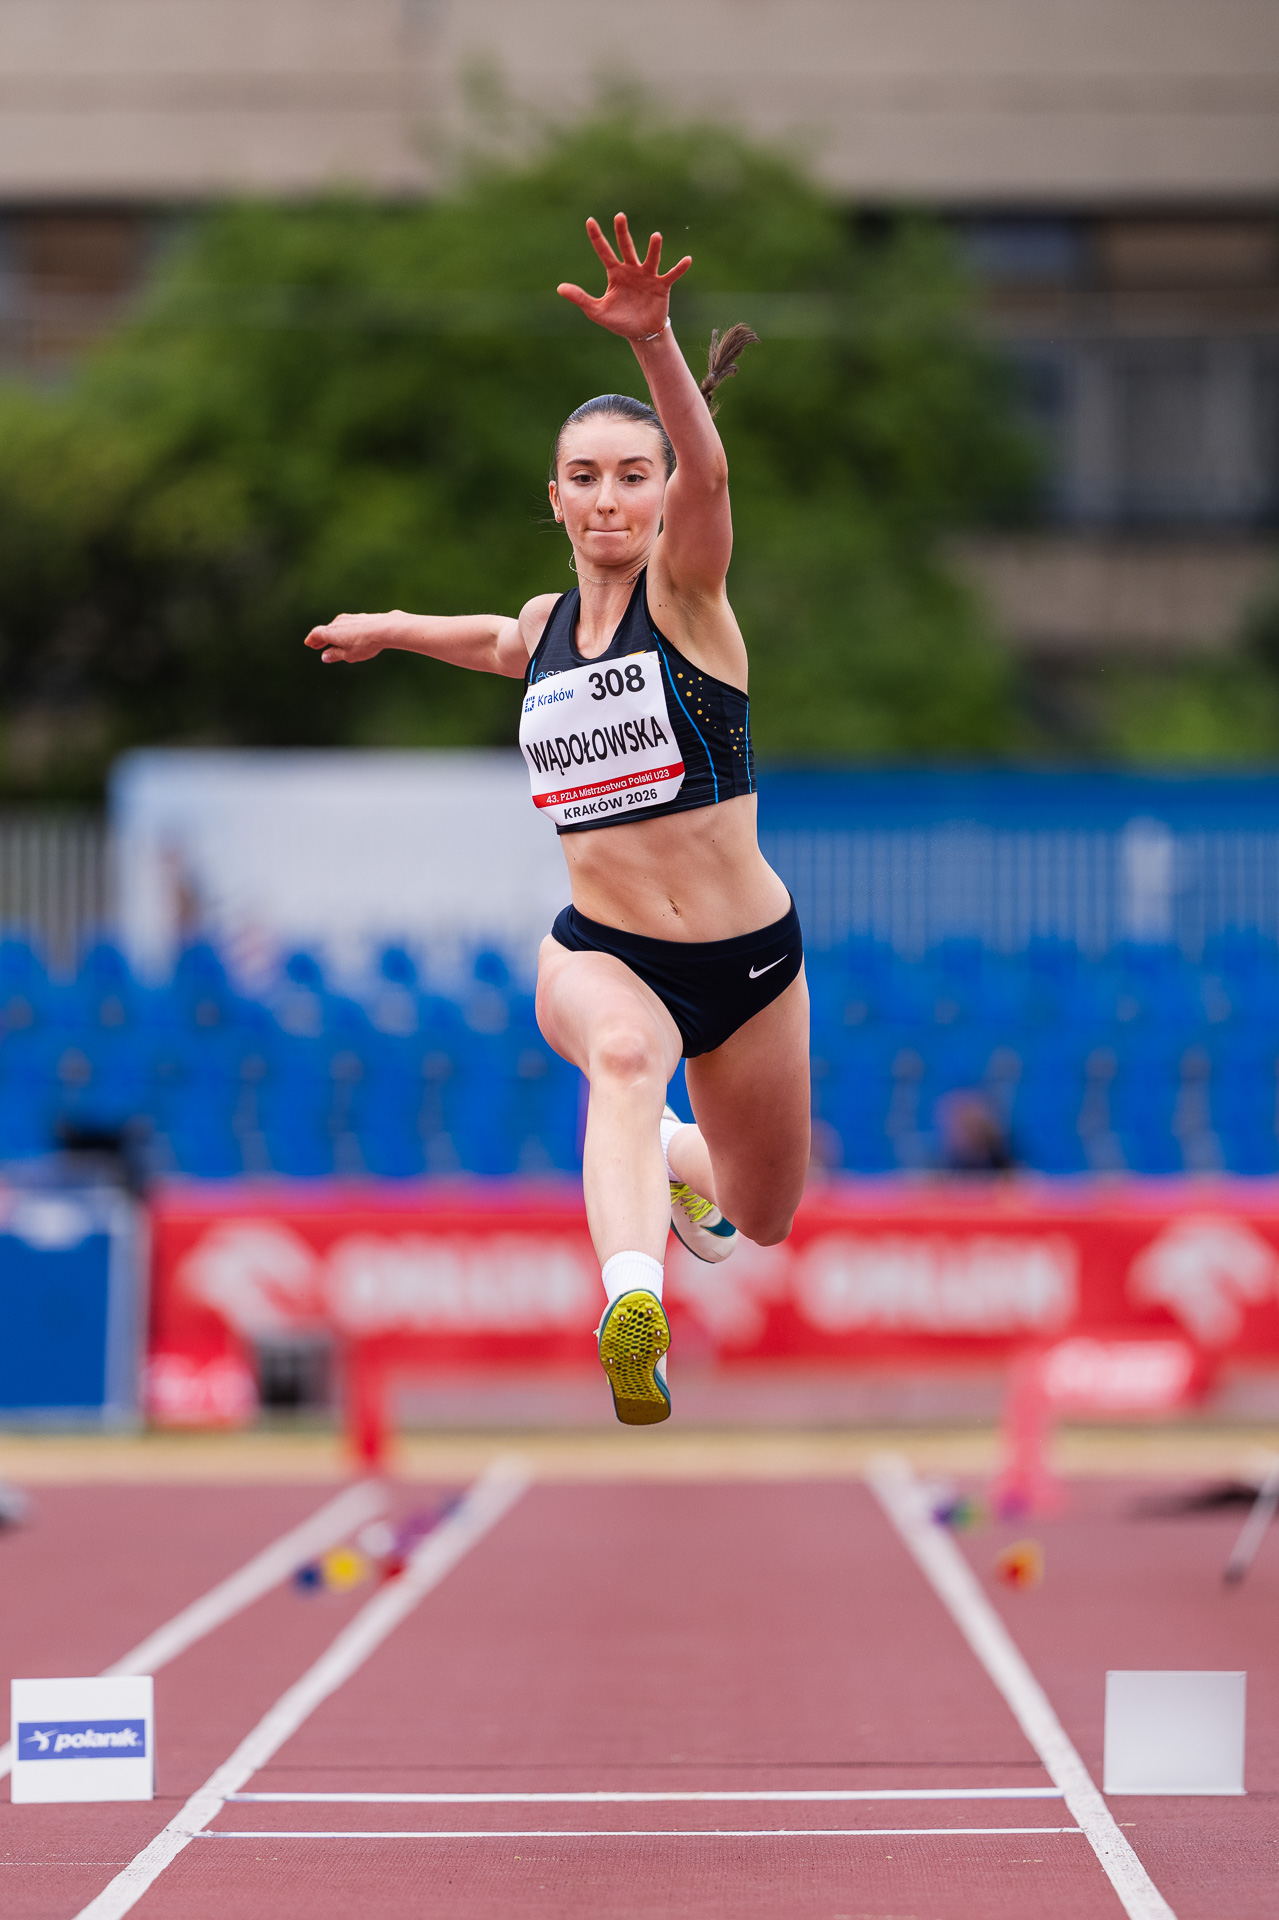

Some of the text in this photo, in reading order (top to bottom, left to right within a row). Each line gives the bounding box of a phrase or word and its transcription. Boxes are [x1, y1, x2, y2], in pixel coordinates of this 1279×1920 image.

[537, 687, 574, 707] Kraków
[588, 664, 645, 701] 308
[526, 716, 669, 776] WĄDOŁOWSKA
[546, 769, 670, 804] 43. PZLA Mistrzostwa Polski U23
[563, 788, 658, 819] KRAKÓW 2026
